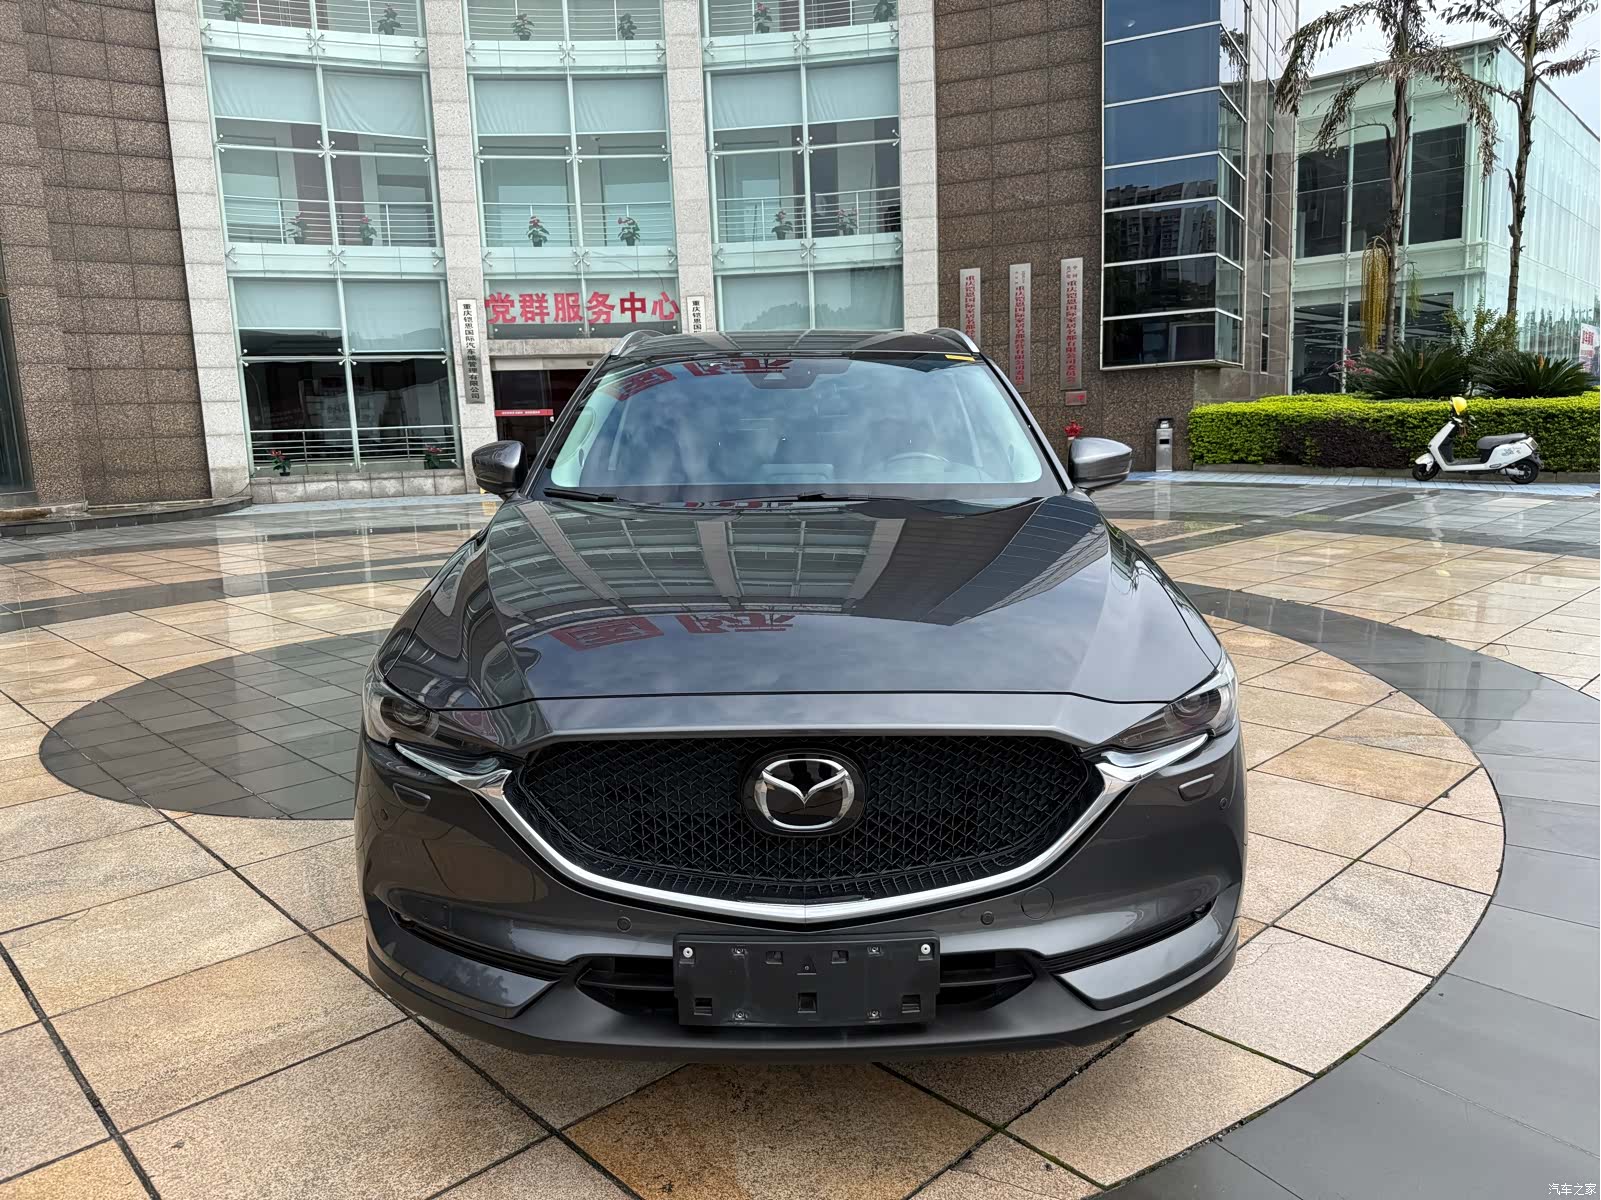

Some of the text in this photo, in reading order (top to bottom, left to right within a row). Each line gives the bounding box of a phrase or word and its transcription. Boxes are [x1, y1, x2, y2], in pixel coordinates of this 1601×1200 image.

[484, 291, 681, 325] 党群服务中心
[462, 303, 480, 399] 重庆铠恩国际汽车城管理有限公司
